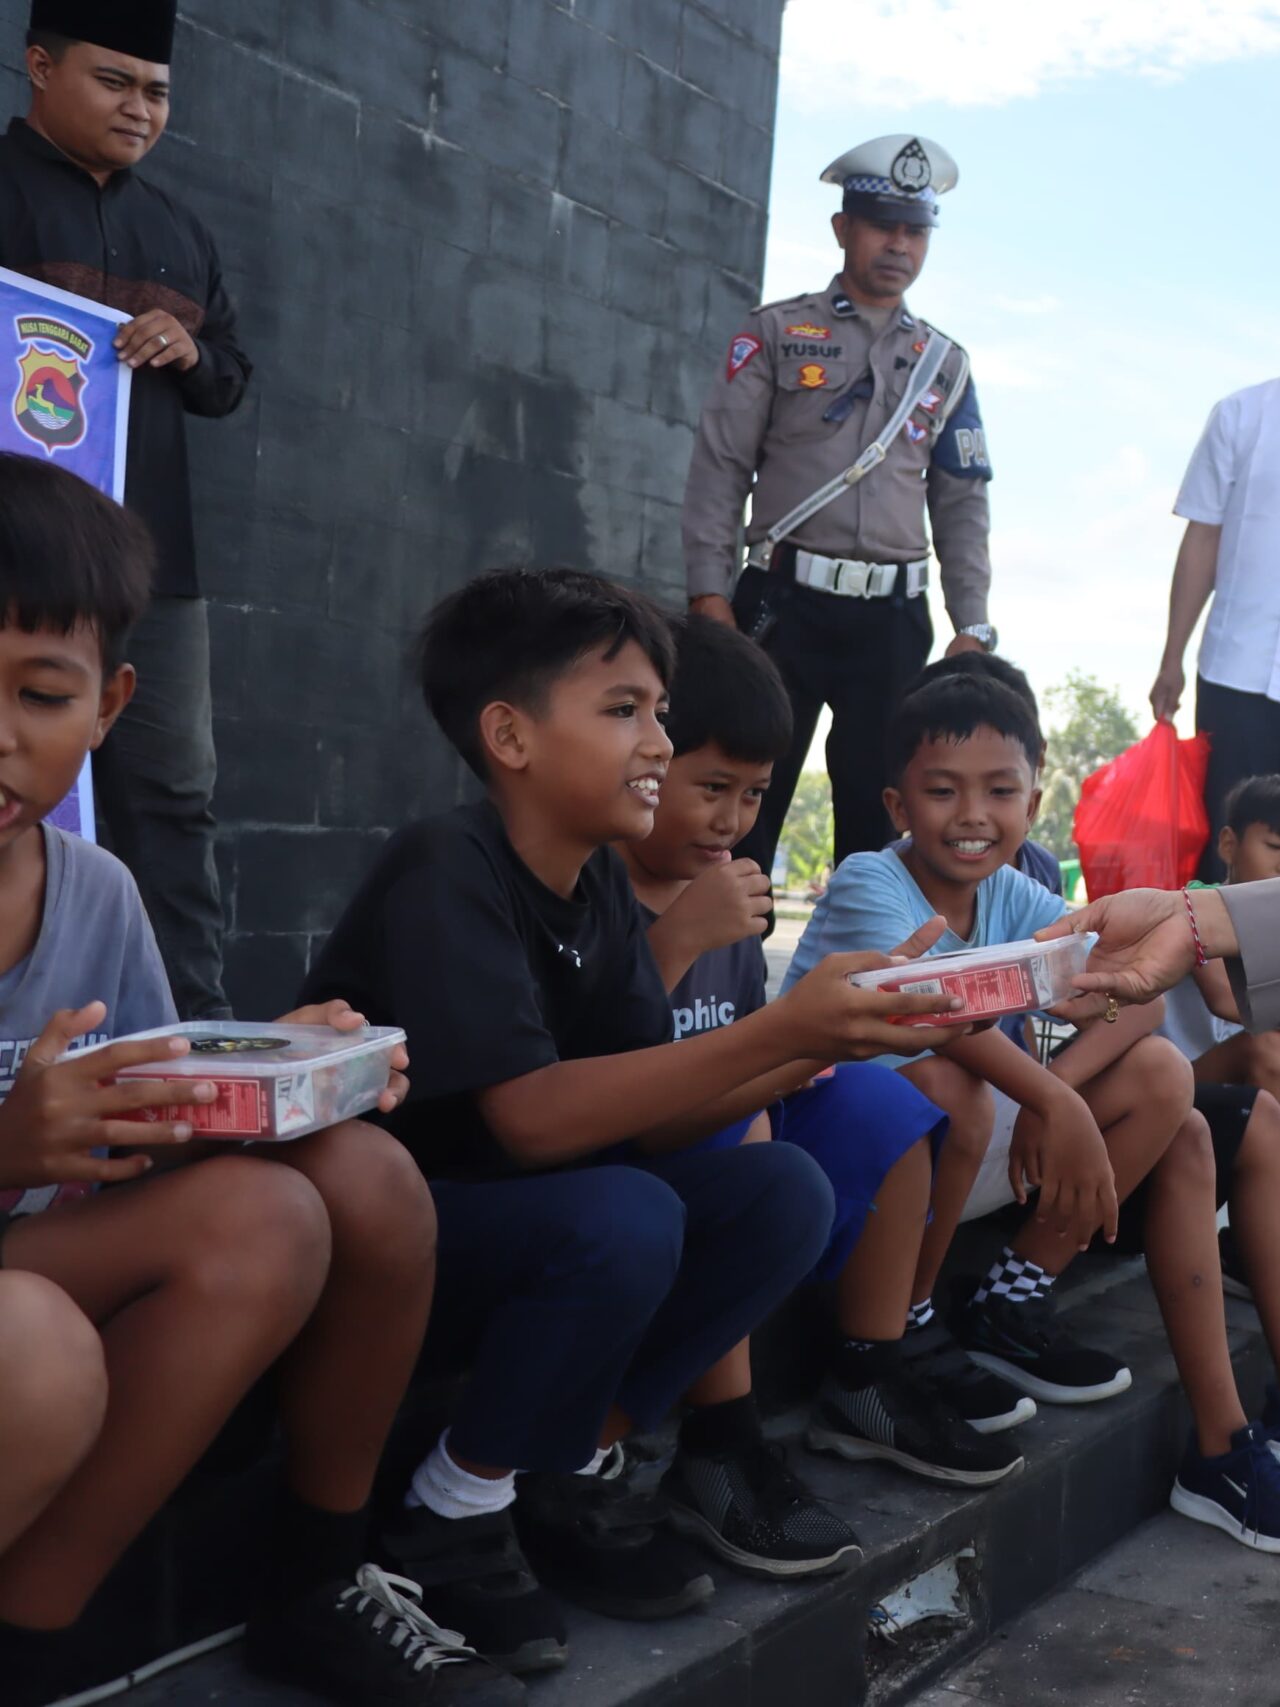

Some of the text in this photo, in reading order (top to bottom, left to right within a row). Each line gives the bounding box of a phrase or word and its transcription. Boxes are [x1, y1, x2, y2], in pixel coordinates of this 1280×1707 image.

[38, 322, 69, 340] TENGGARA
[70, 334, 88, 353] BARAT
[781, 342, 843, 359] YUSUF
